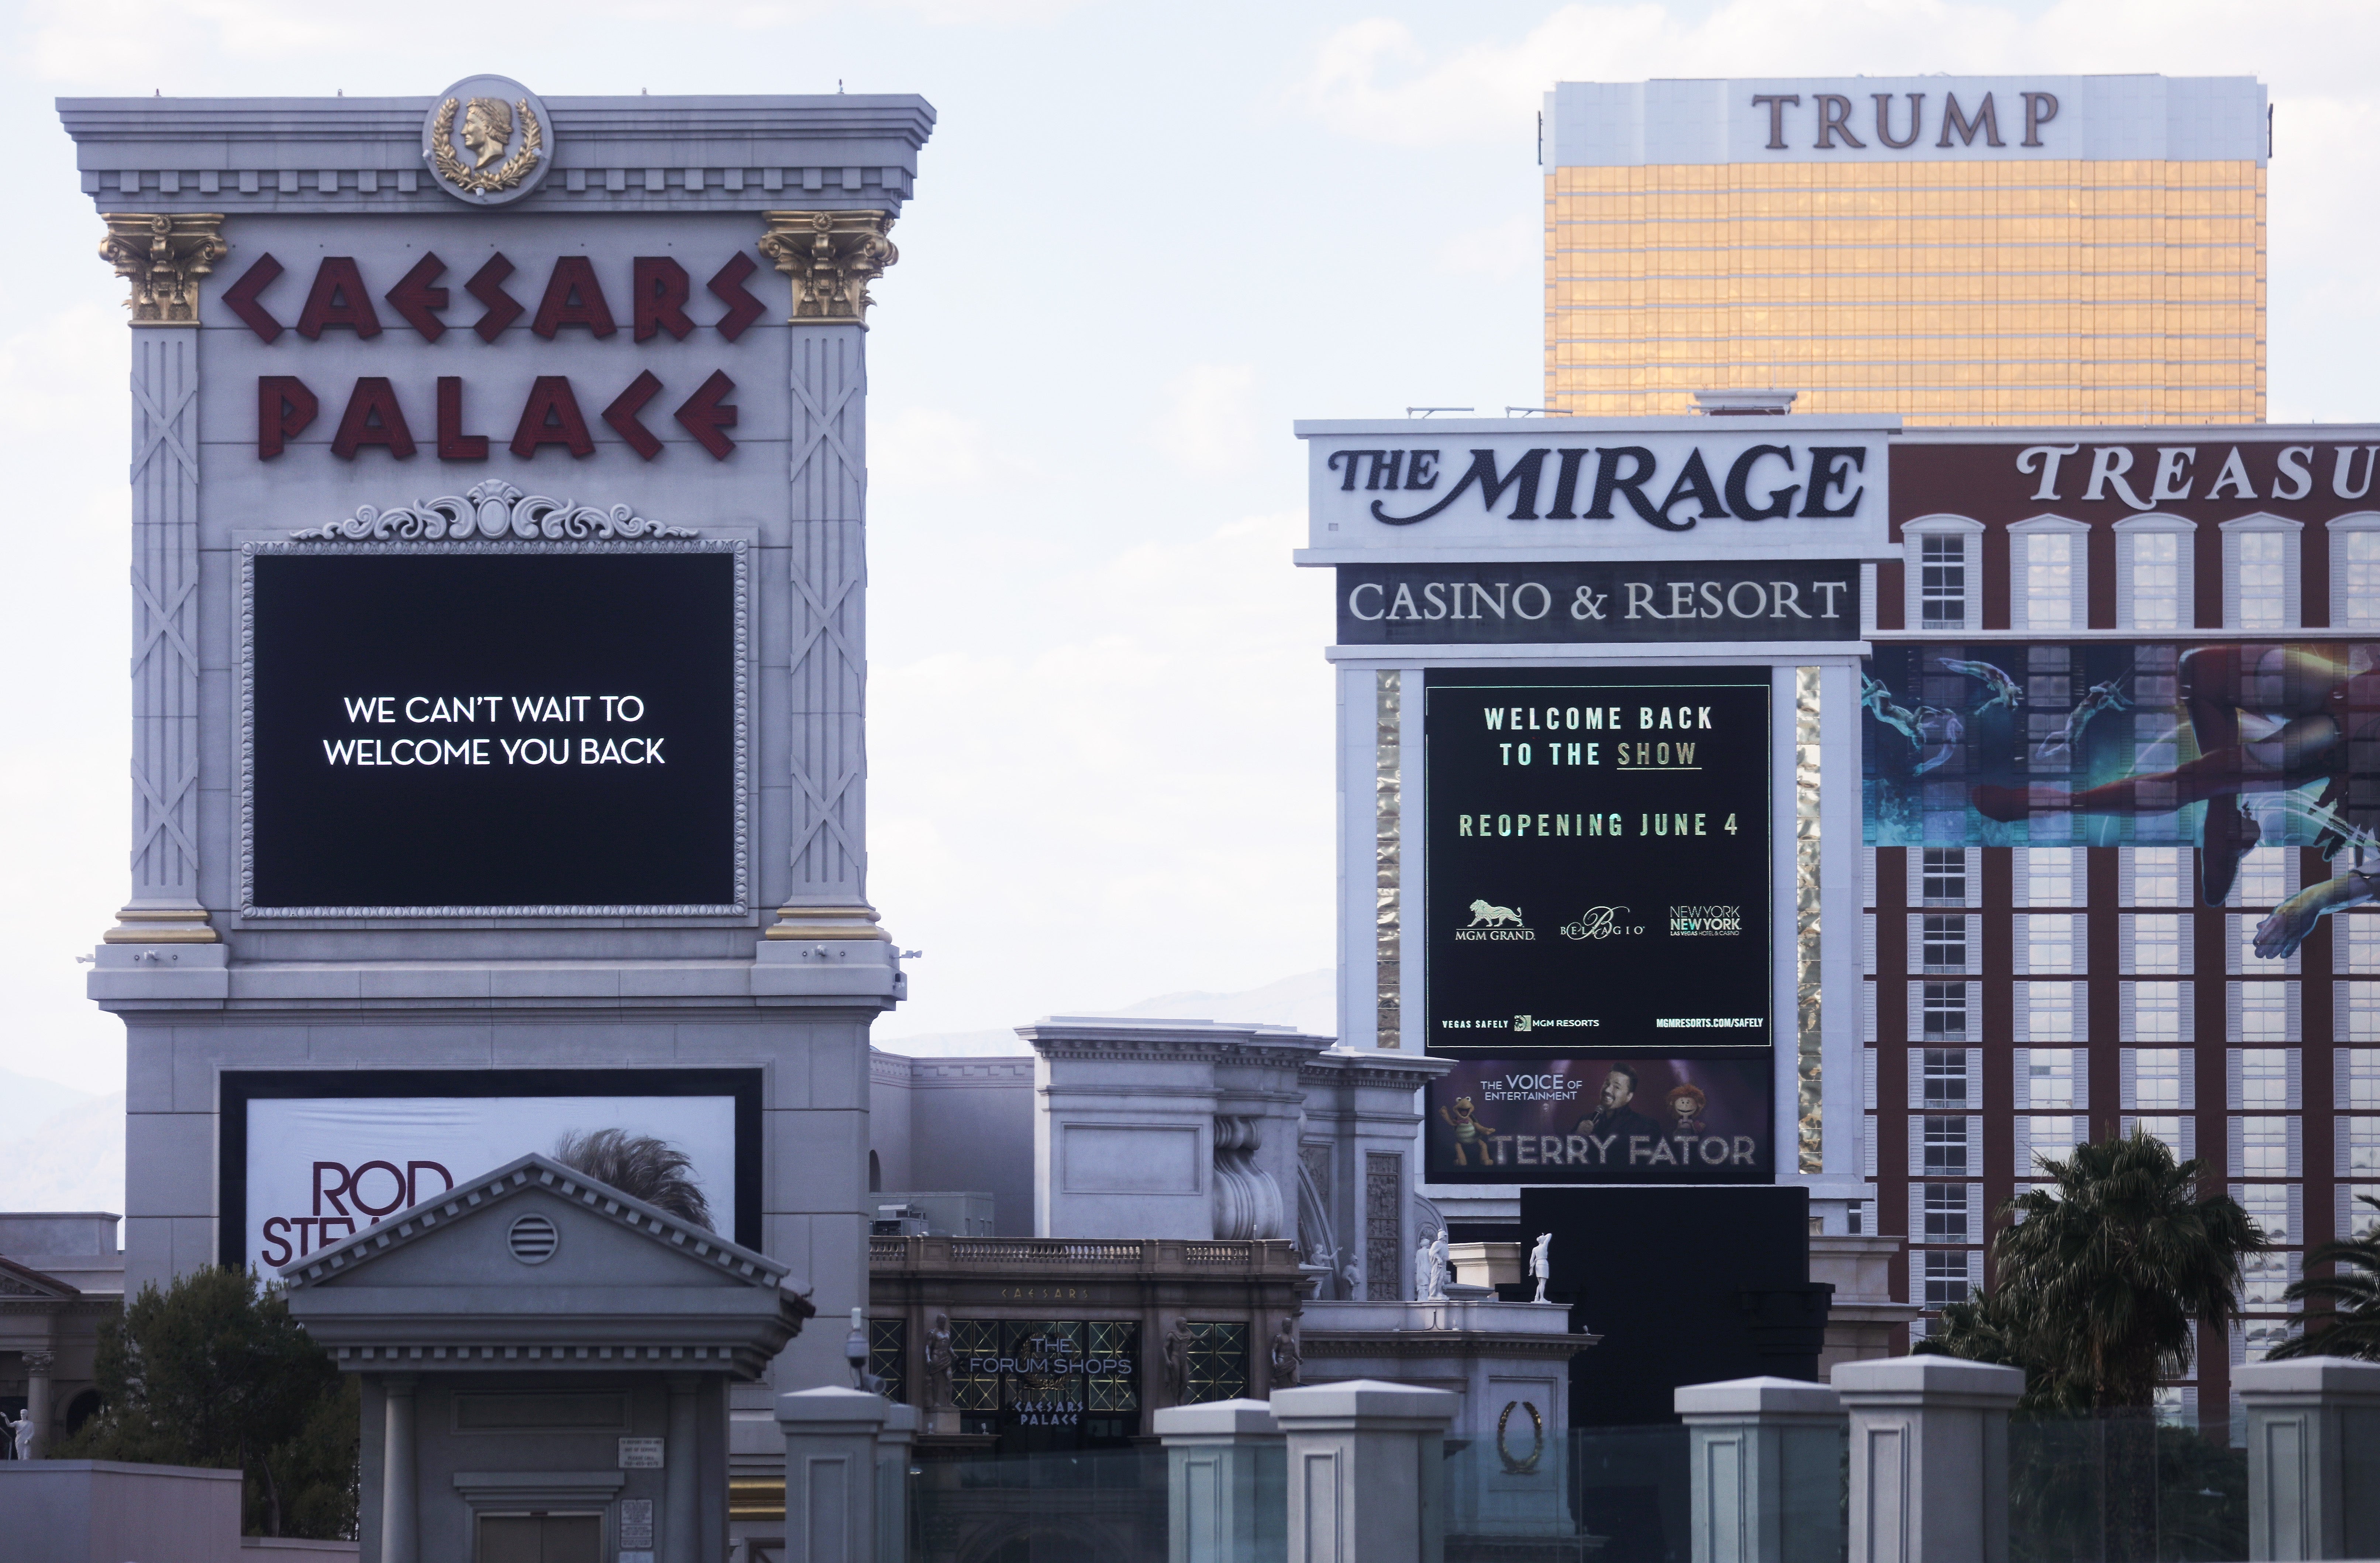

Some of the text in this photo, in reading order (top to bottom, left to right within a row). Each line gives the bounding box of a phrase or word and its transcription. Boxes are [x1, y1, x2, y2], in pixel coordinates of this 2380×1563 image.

[1751, 90, 2061, 149] TRUMP
[220, 250, 768, 345] CAESARS
[255, 369, 739, 462] PALACE
[1327, 444, 1867, 531] THE MIRAGE
[2016, 443, 2380, 511] TREASU
[1349, 581, 1847, 621] CASINO & RESORT
[344, 695, 644, 723] WE CAN’T WAIT TO
[1484, 706, 1712, 730] WELCOME BACK
[323, 738, 665, 765] WELCOME YOU BACK
[1499, 742, 1695, 766] TO THE SHOW
[1460, 813, 1737, 837] REOPENING JUNE 4
[1455, 931, 1535, 941] MGM GRAND
[1442, 1020, 1471, 1028] VEGAS
[1475, 1020, 1508, 1028] SAFELY
[1656, 1018, 1763, 1028] MGMRESORTS.COM/SAFELY
[1480, 1074, 1582, 1090] THE VOICE OF
[1485, 1091, 1577, 1100] ENTERTAINMENT
[1488, 1135, 1756, 1165] TERRY FATOR
[313, 1160, 454, 1216] ROD
[1002, 1288, 1088, 1298] CAESARS
[1031, 1338, 1073, 1352] THE
[970, 1358, 1132, 1374] FORUM SHOPS
[1015, 1401, 1084, 1412] CAESARS
[1021, 1414, 1078, 1425] PALACE
